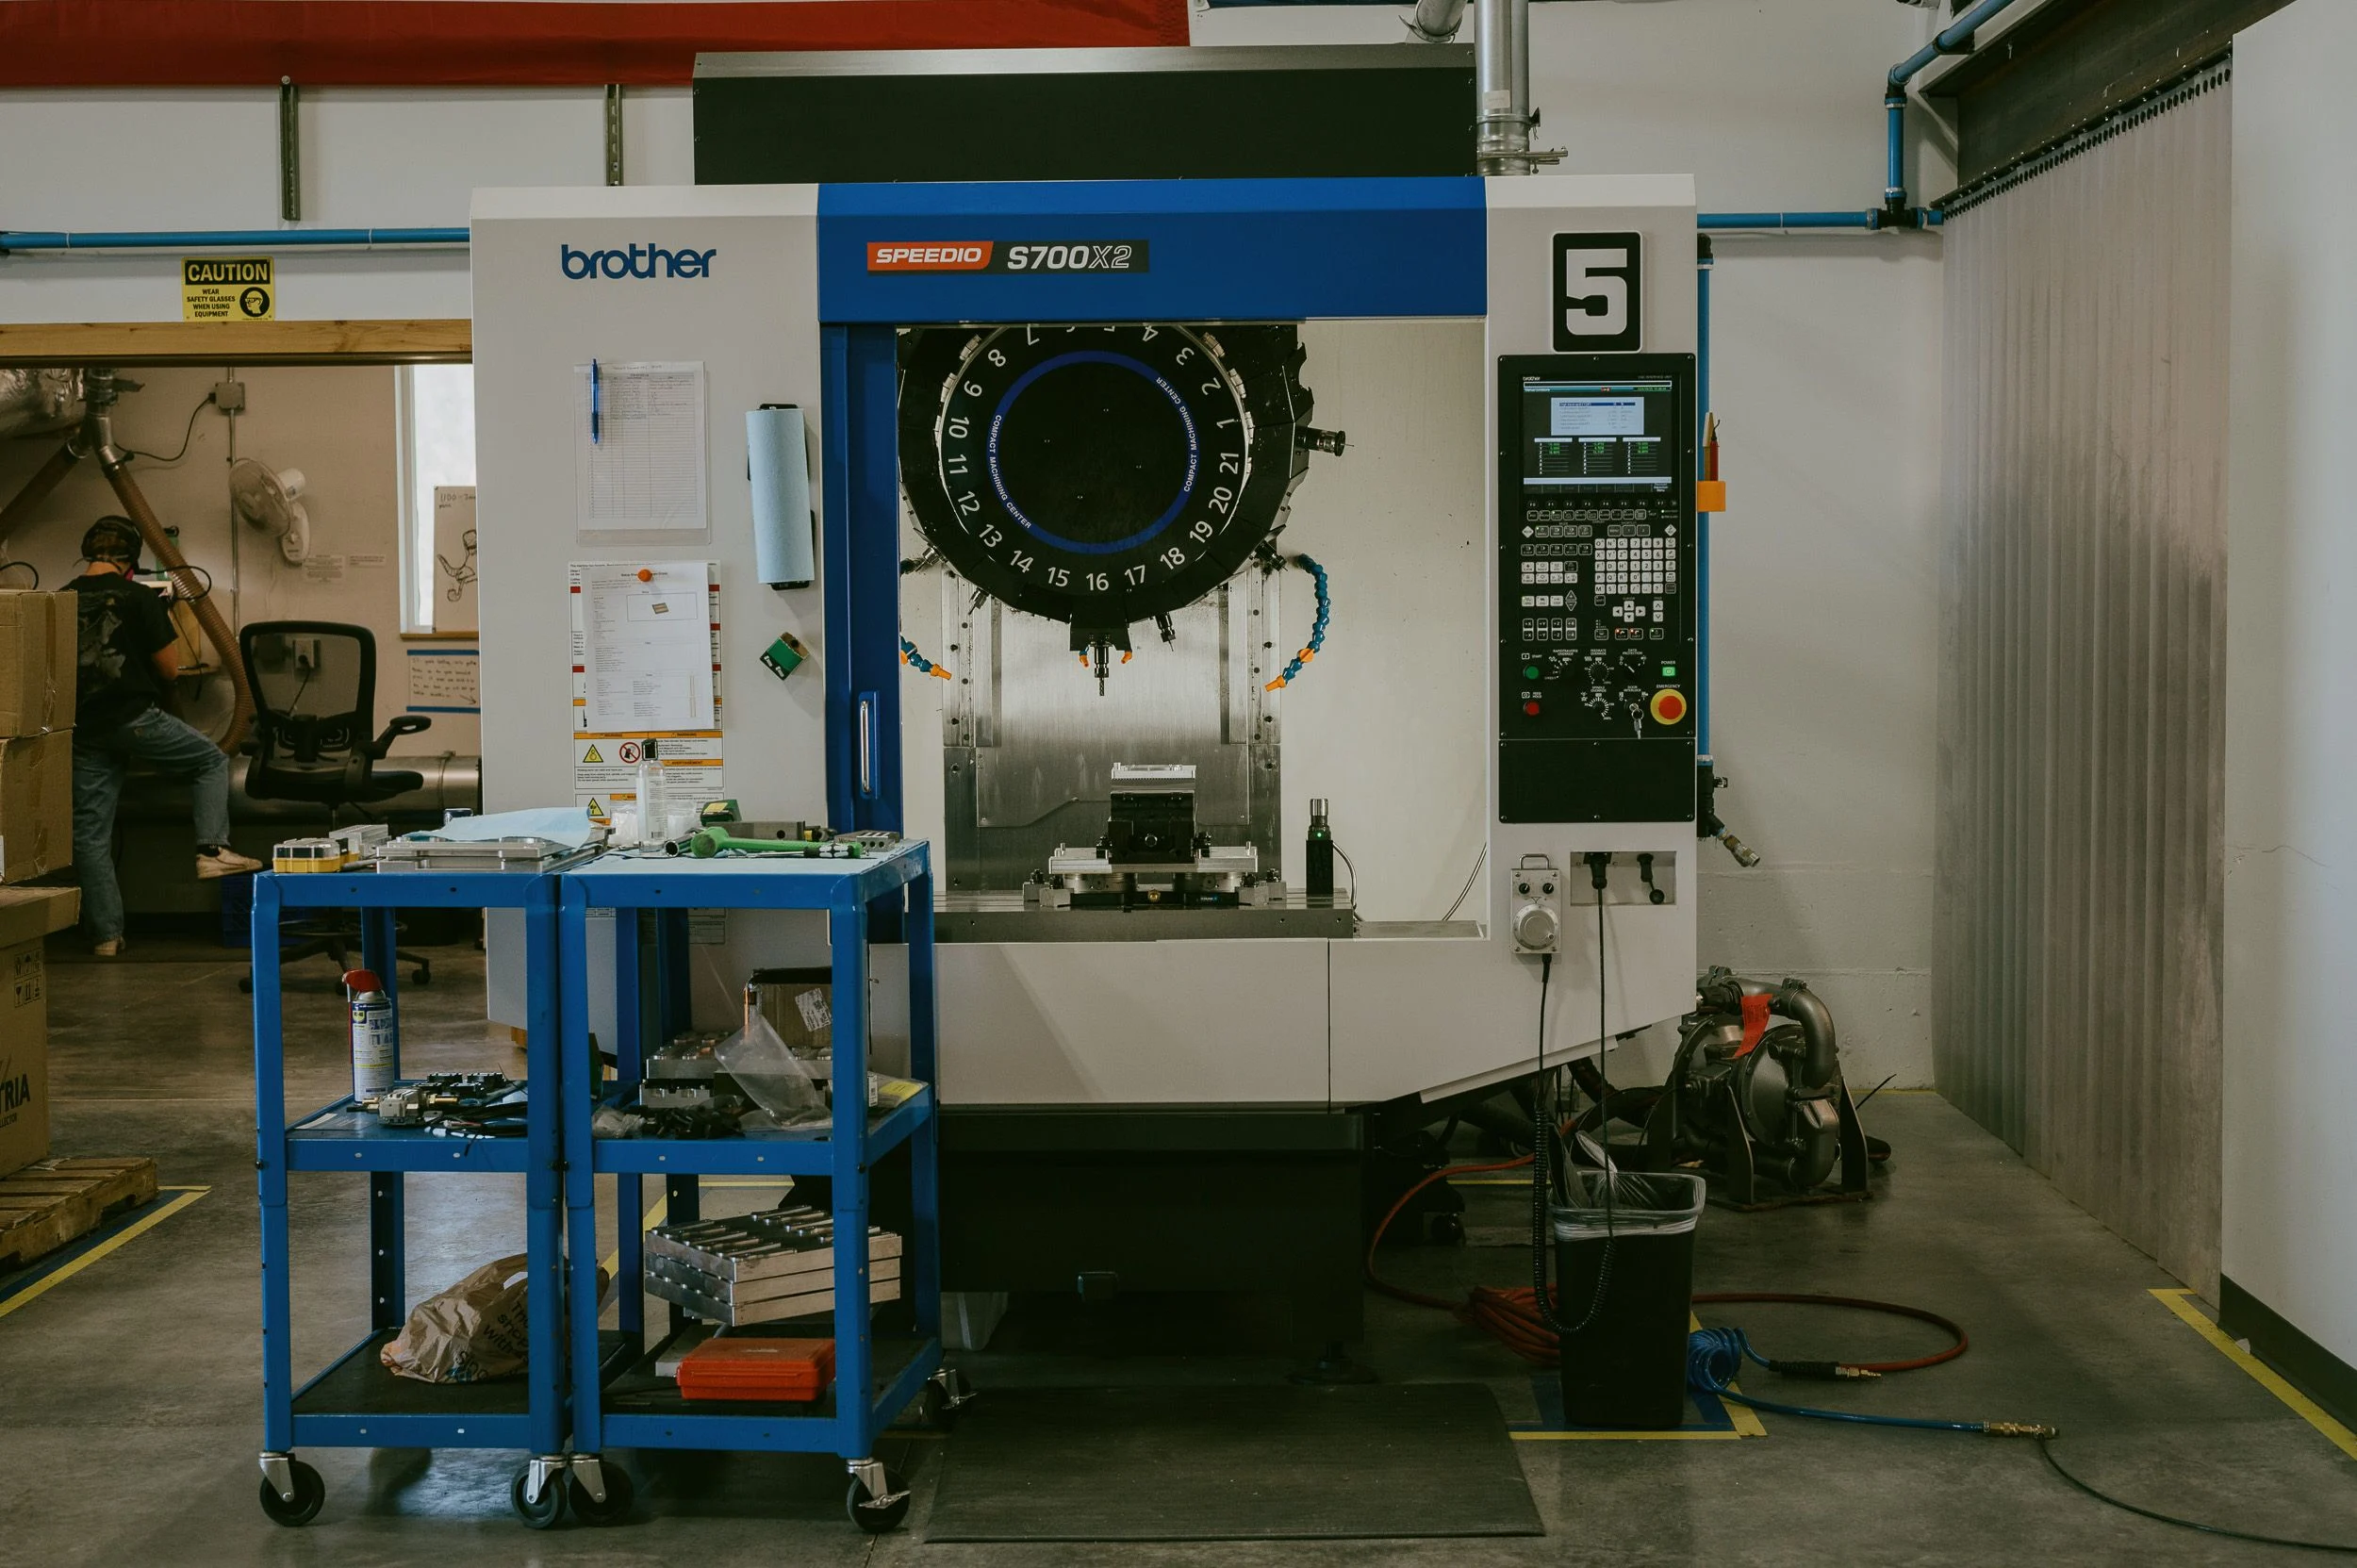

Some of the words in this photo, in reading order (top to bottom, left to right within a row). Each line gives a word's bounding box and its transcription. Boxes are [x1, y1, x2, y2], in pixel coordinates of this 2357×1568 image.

[561, 243, 717, 279] brother
[876, 247, 981, 264] SPEEDIO
[1007, 245, 1132, 270] S700X2
[188, 263, 268, 282] CAUTION
[1566, 248, 1628, 336] 5
[1027, 324, 1040, 345] 7
[1142, 323, 1159, 342] 4
[988, 349, 1006, 368] 8
[1176, 347, 1195, 366] 3
[964, 380, 982, 397] 9
[1156, 377, 1181, 404] CENTER
[1201, 377, 1221, 395] 2
[948, 417, 970, 438] 10
[989, 415, 1002, 454] COMPACT
[1179, 405, 1197, 451] MACHINING
[1216, 419, 1235, 429] 1
[948, 454, 968, 474] 11
[1183, 454, 1197, 492] COMPACT
[1219, 452, 1239, 474] 21
[989, 456, 1008, 501] MACHINING
[957, 490, 981, 516] 12
[1209, 487, 1232, 514] 20
[1006, 502, 1031, 529] CENTER
[979, 523, 1003, 547] 13
[1189, 520, 1213, 543] 19
[1010, 550, 1034, 573] 14
[1160, 547, 1186, 569] 18
[1047, 567, 1070, 587] 15
[1086, 573, 1110, 591] 16
[1124, 565, 1146, 586] 17
